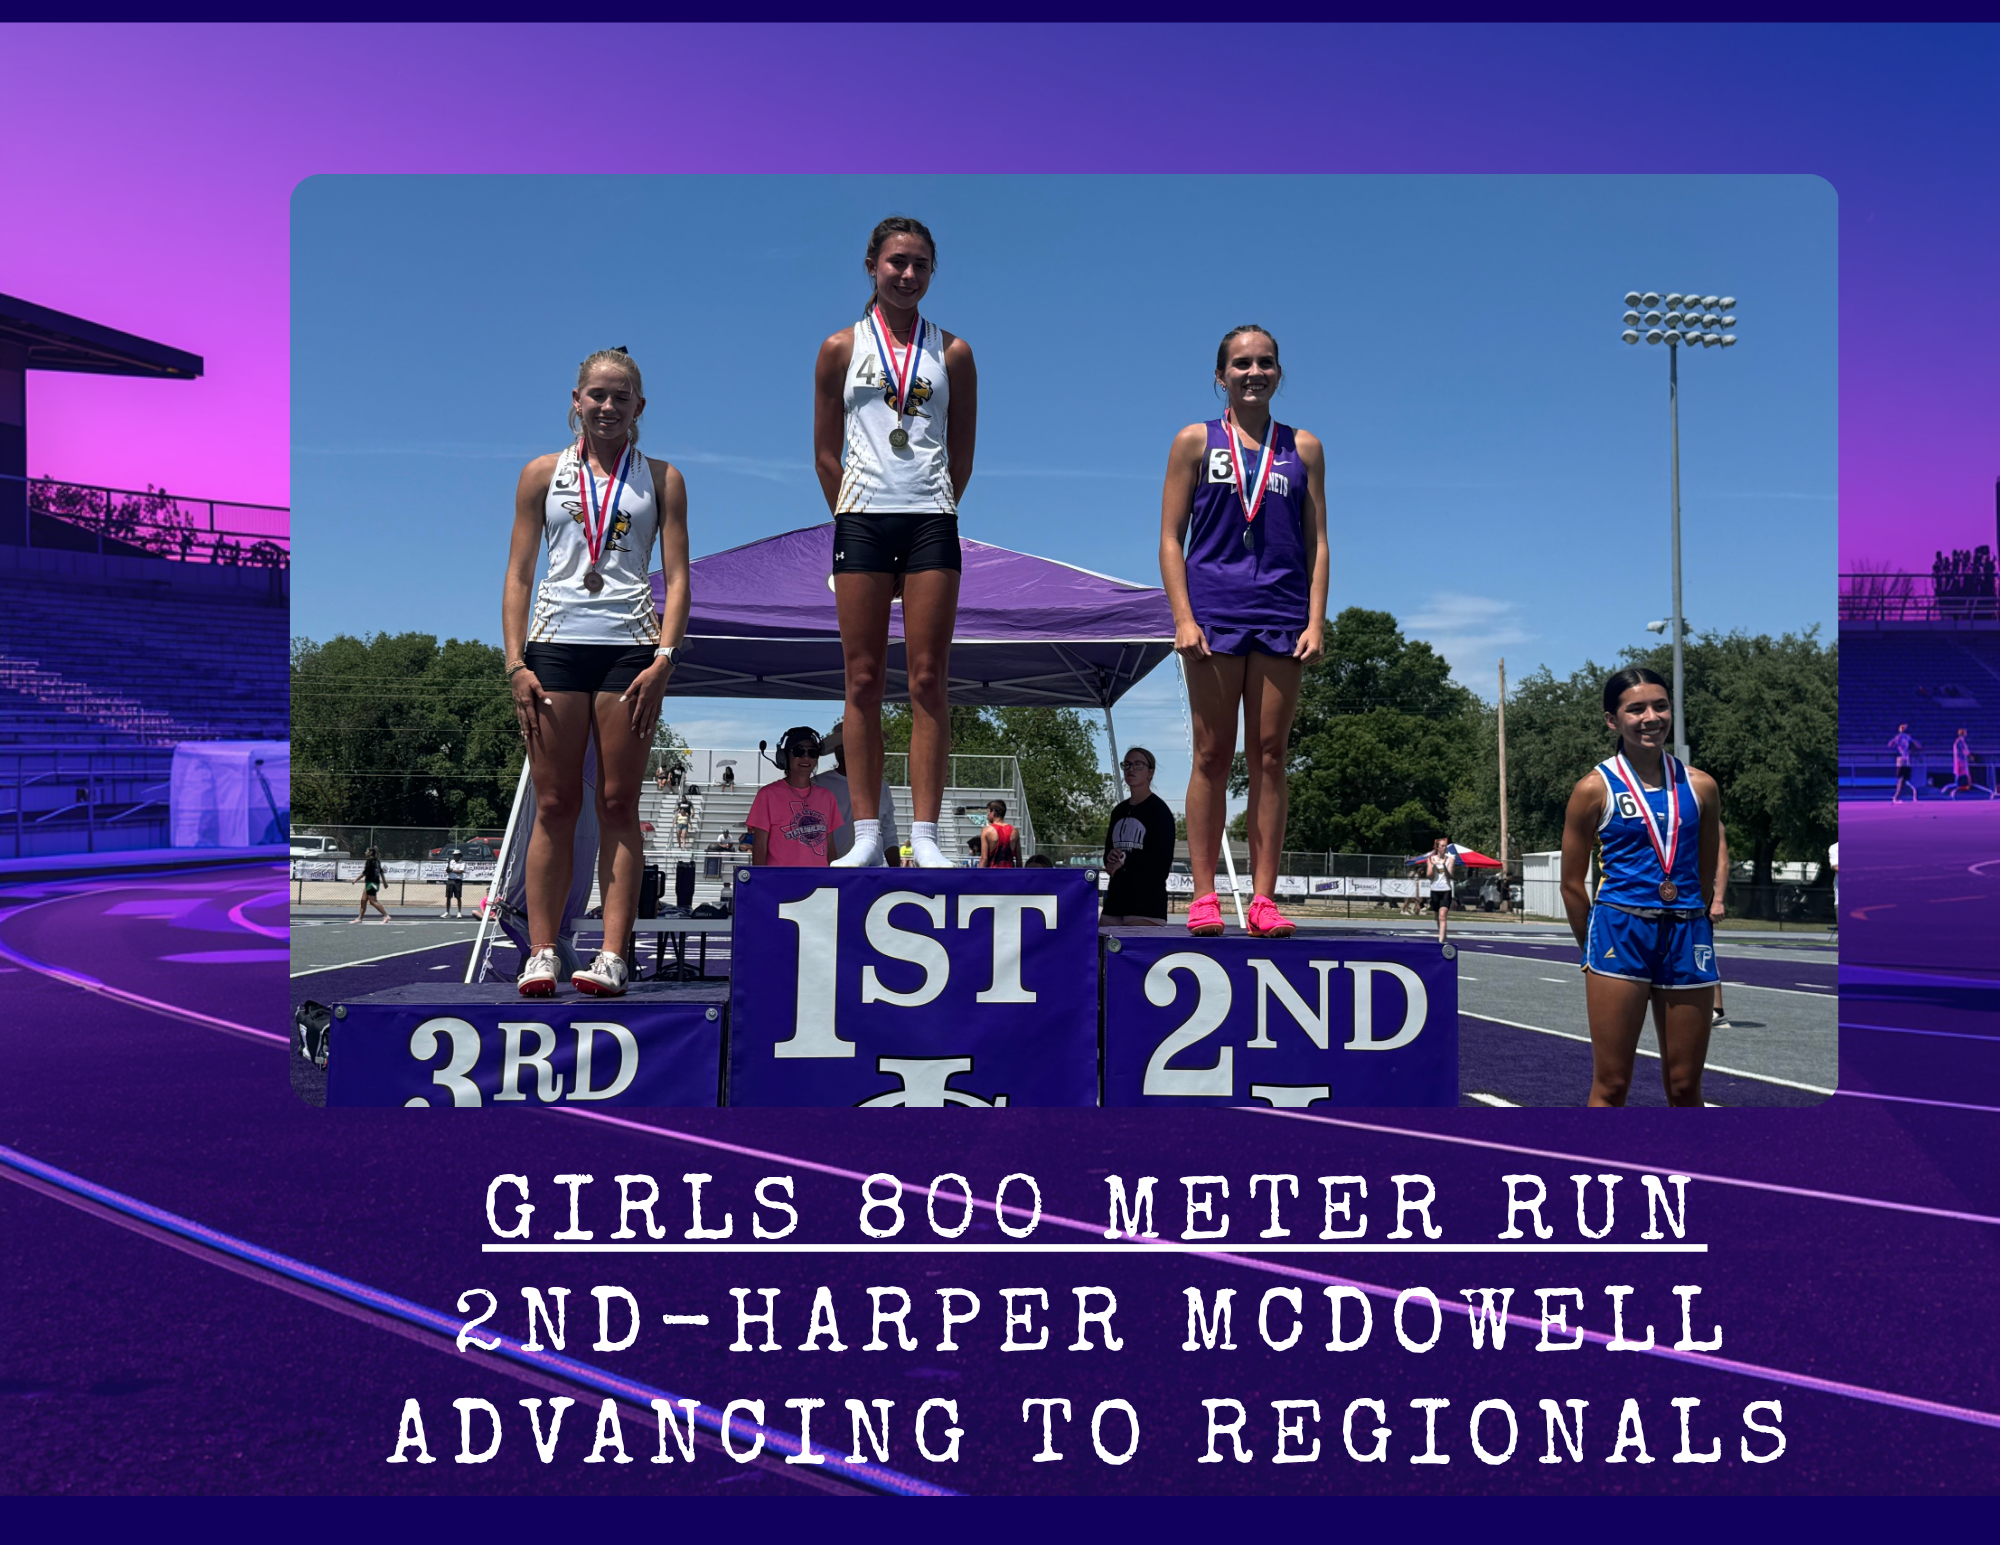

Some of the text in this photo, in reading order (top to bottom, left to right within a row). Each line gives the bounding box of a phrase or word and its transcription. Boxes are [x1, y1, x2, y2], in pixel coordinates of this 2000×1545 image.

[856, 354, 876, 385] 4
[1212, 451, 1234, 479] 3
[1266, 471, 1289, 497] NETS
[1618, 793, 1637, 817] 6
[388, 866, 418, 875] Discovery
[774, 887, 1058, 1059] 1ST
[1143, 952, 1428, 1096] 2ND
[404, 1017, 639, 1107] 3RD
